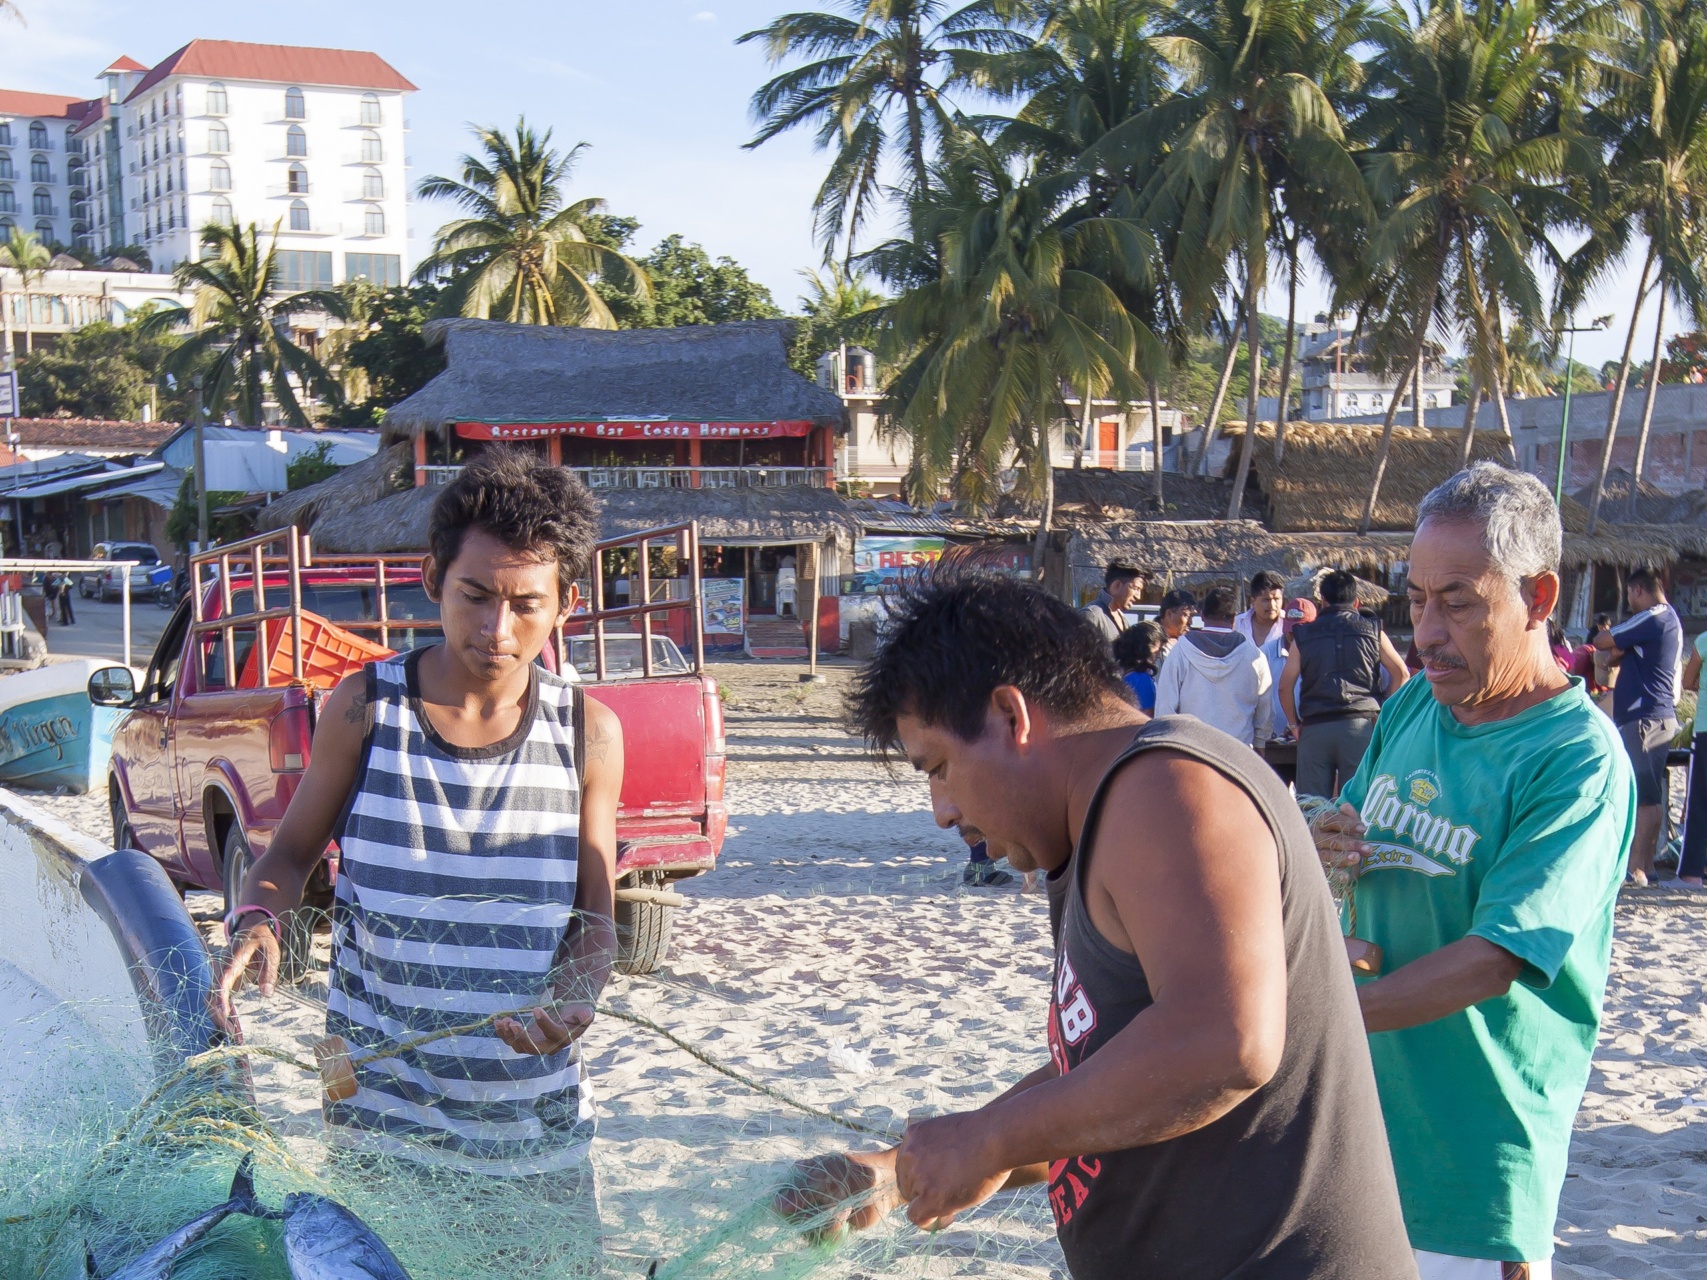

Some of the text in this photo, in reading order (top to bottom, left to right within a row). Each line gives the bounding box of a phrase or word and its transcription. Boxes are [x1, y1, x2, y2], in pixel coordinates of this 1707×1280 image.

[490, 425, 586, 437] Restaurant
[596, 424, 624, 436] Bar
[1360, 773, 1482, 866] Corona
[1363, 844, 1414, 867] Extra
